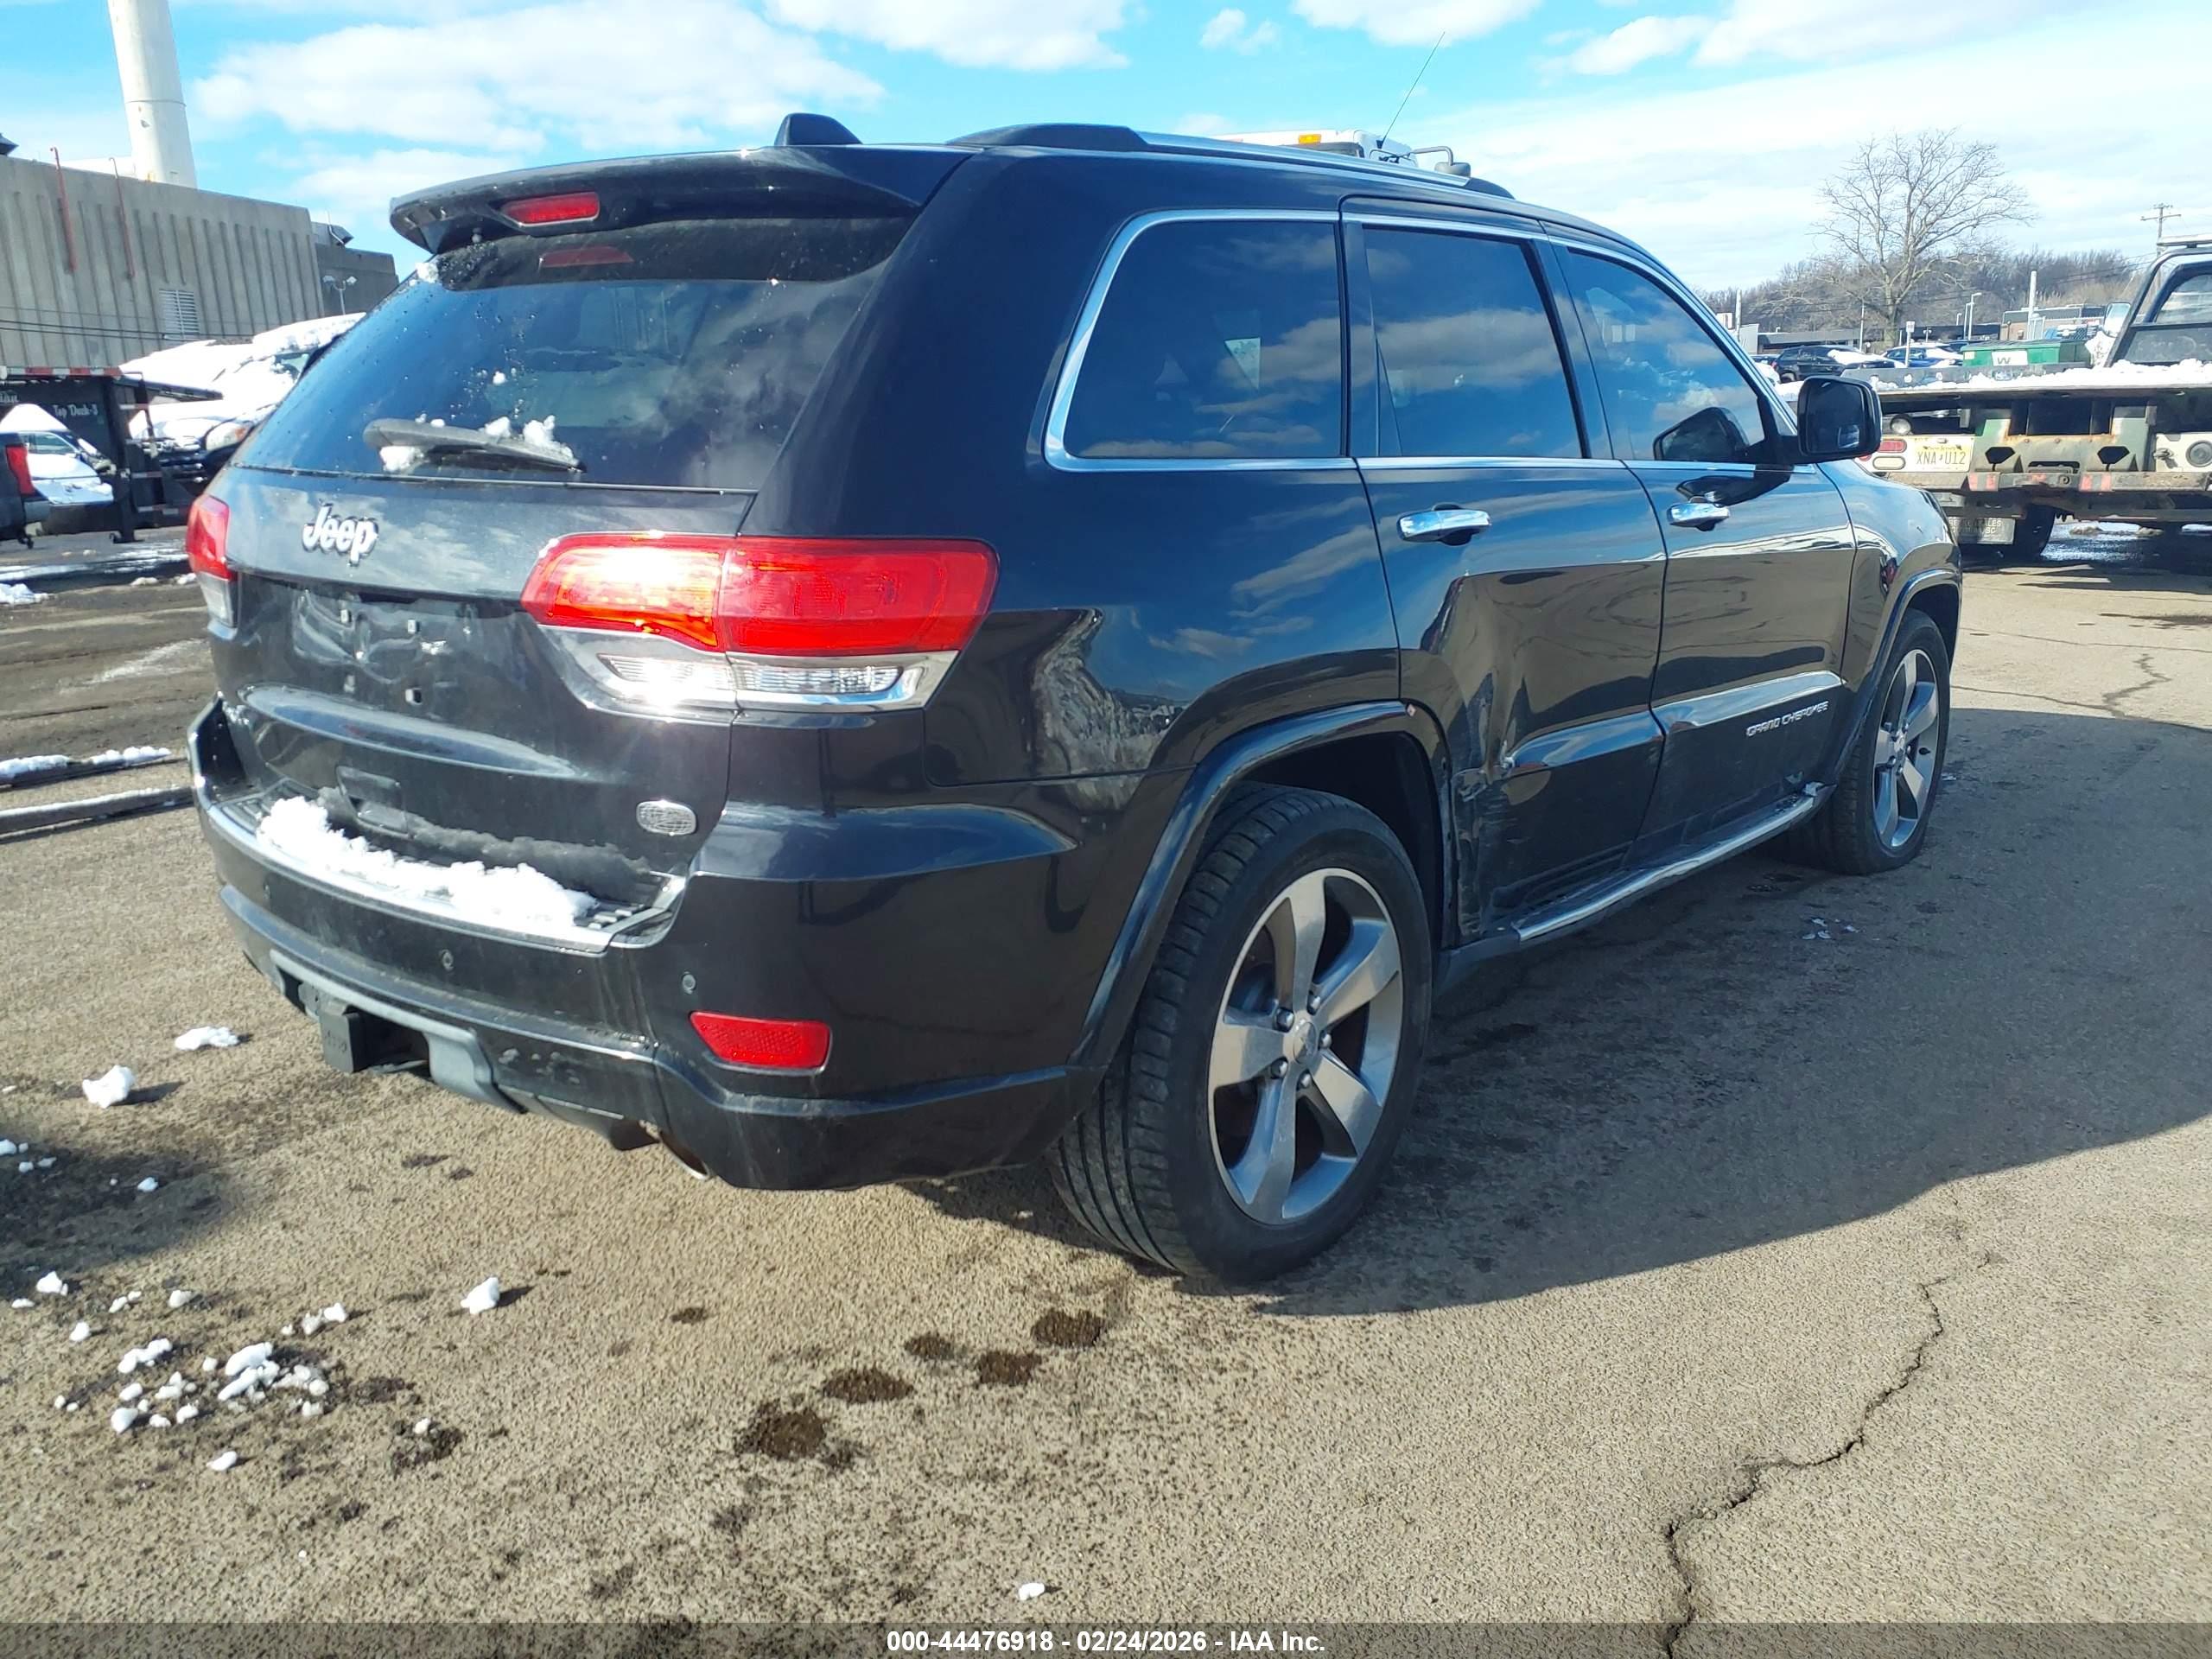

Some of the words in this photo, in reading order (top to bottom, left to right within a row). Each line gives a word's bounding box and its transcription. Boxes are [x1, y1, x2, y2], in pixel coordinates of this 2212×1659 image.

[302, 503, 378, 567] Jeep
[1746, 717, 1780, 737] GRAND
[1781, 701, 1829, 726] CHEROKEE
